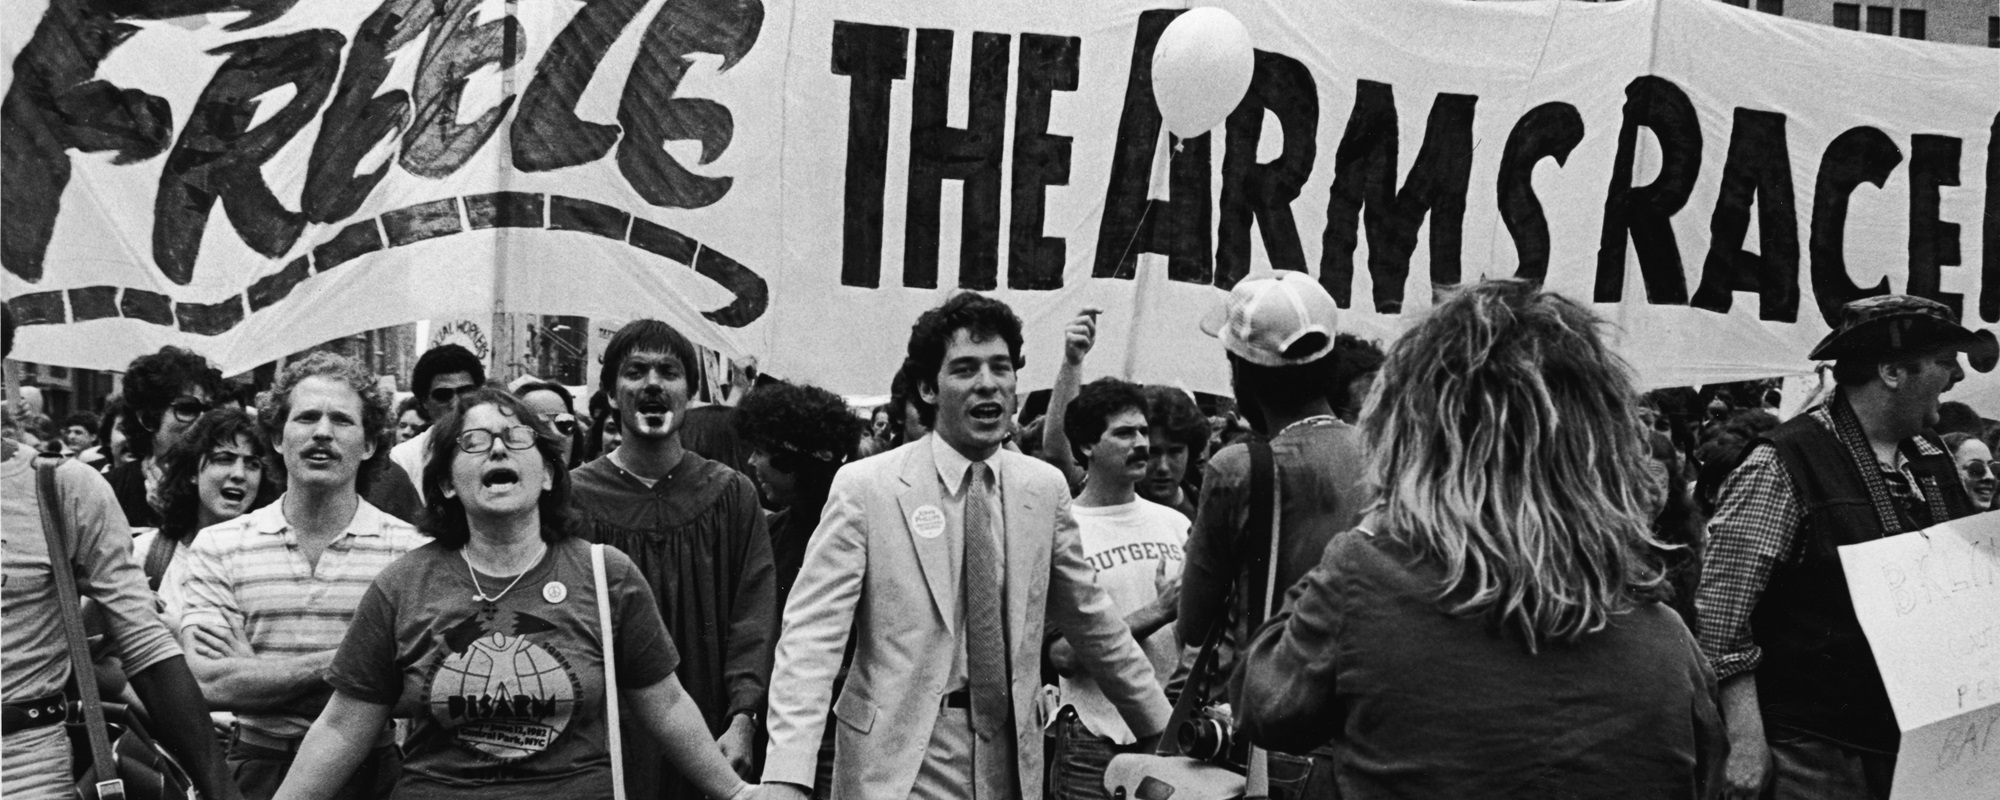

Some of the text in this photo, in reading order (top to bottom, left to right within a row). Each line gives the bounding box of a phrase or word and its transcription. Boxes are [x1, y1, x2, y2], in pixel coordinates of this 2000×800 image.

[831, 20, 1082, 290] THE
[1092, 8, 1585, 314] ARMS
[460, 727, 546, 747] Central Park, NYC
[527, 727, 547, 737] 1982
